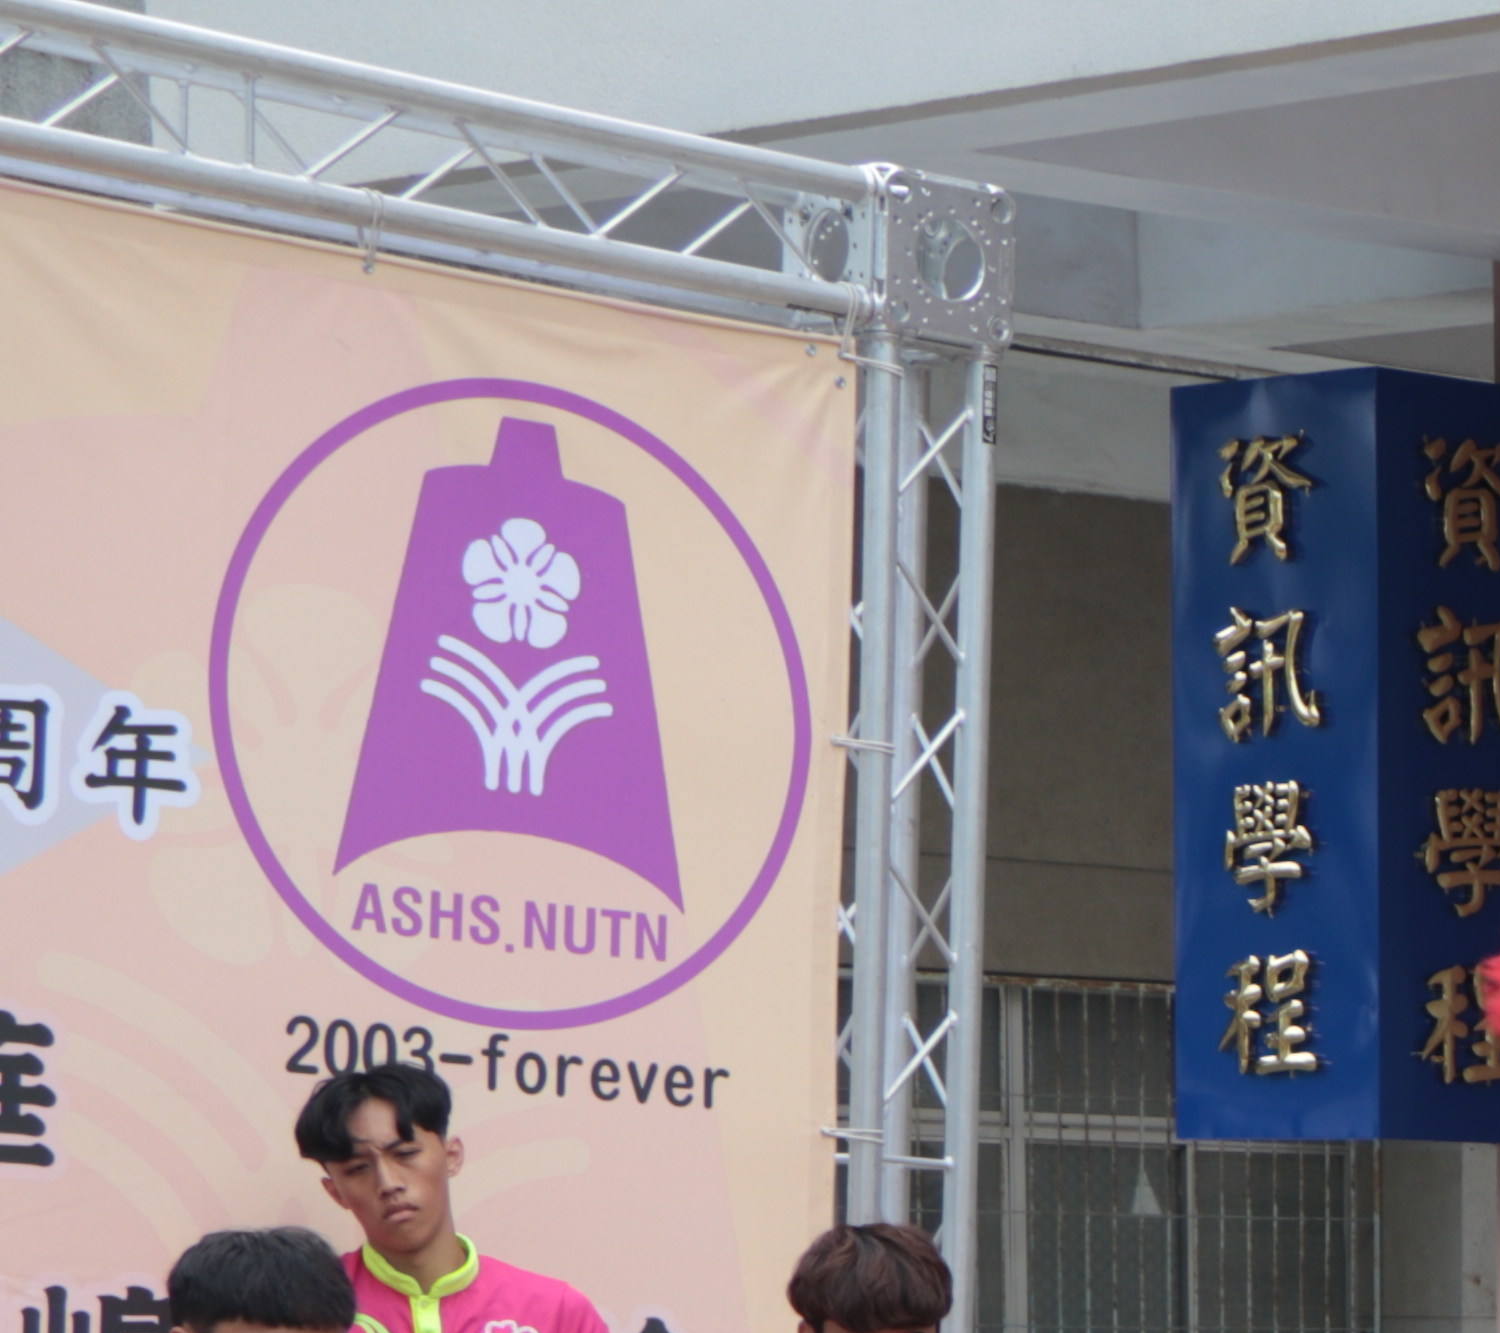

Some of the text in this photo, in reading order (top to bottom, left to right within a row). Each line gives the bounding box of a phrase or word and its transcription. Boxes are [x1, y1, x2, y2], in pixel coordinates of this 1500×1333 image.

[1213, 429, 1321, 1078] 資訊學程
[351, 882, 669, 962] ASHS.NUTN
[285, 1014, 730, 1110] 2003-forever
